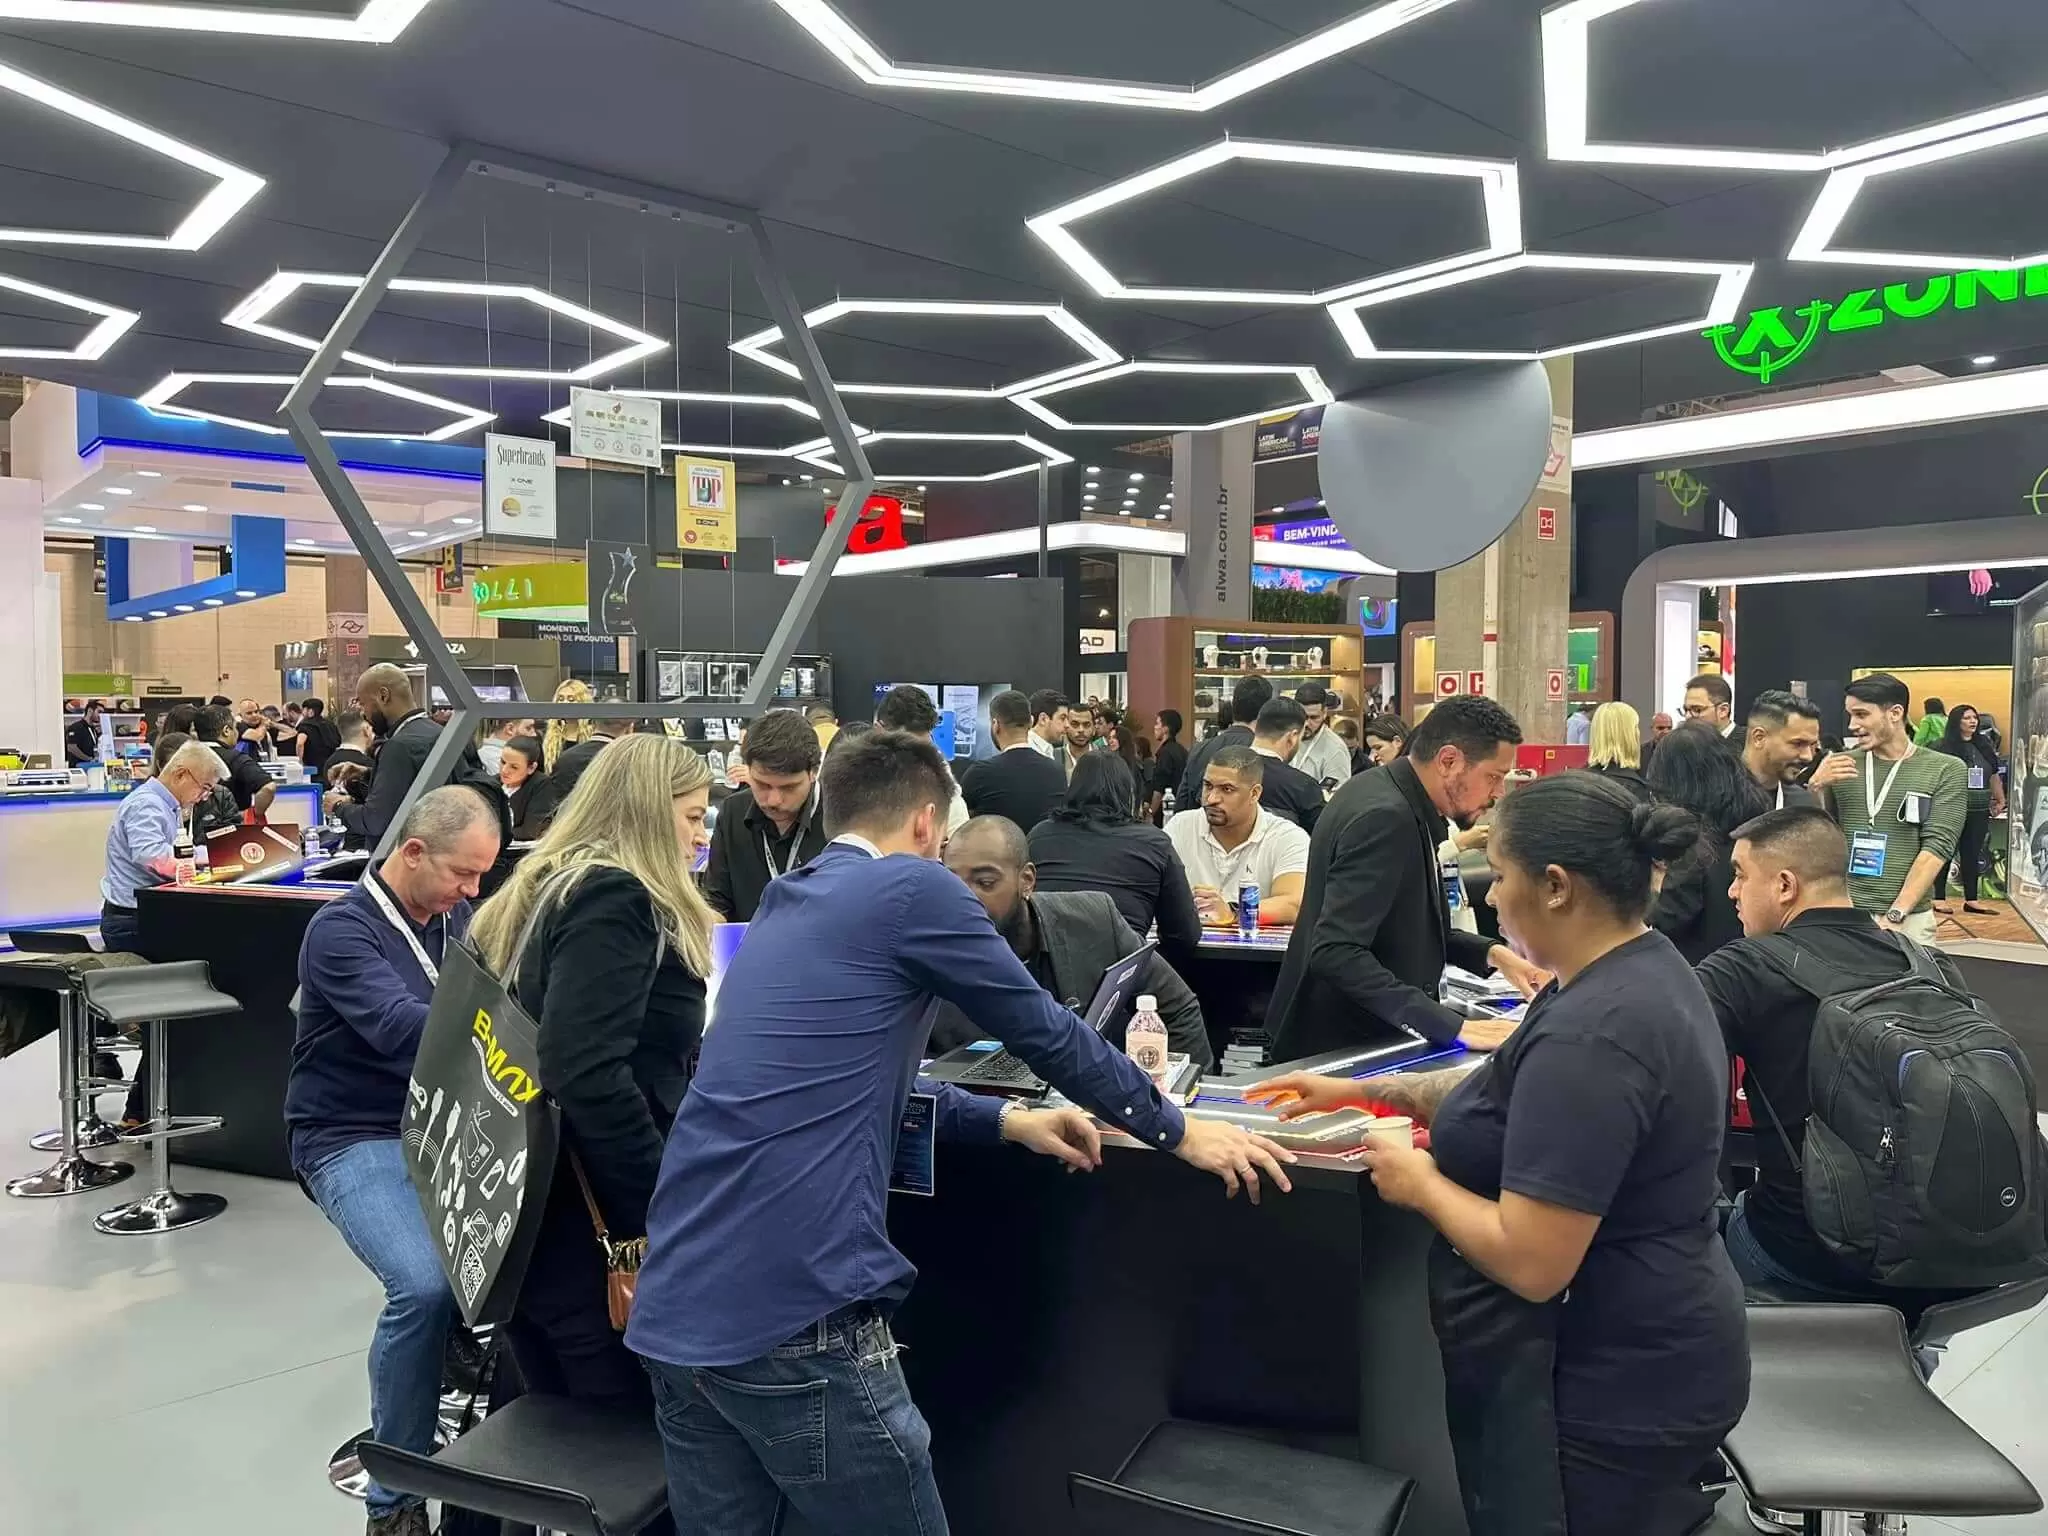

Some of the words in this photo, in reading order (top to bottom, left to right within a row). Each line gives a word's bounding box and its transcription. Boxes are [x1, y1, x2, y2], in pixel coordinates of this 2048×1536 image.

[497, 443, 546, 467] Superbrands
[1283, 524, 1339, 541] BEM-VIND
[539, 634, 560, 642] LINHA
[574, 635, 614, 643] PRODUTOS
